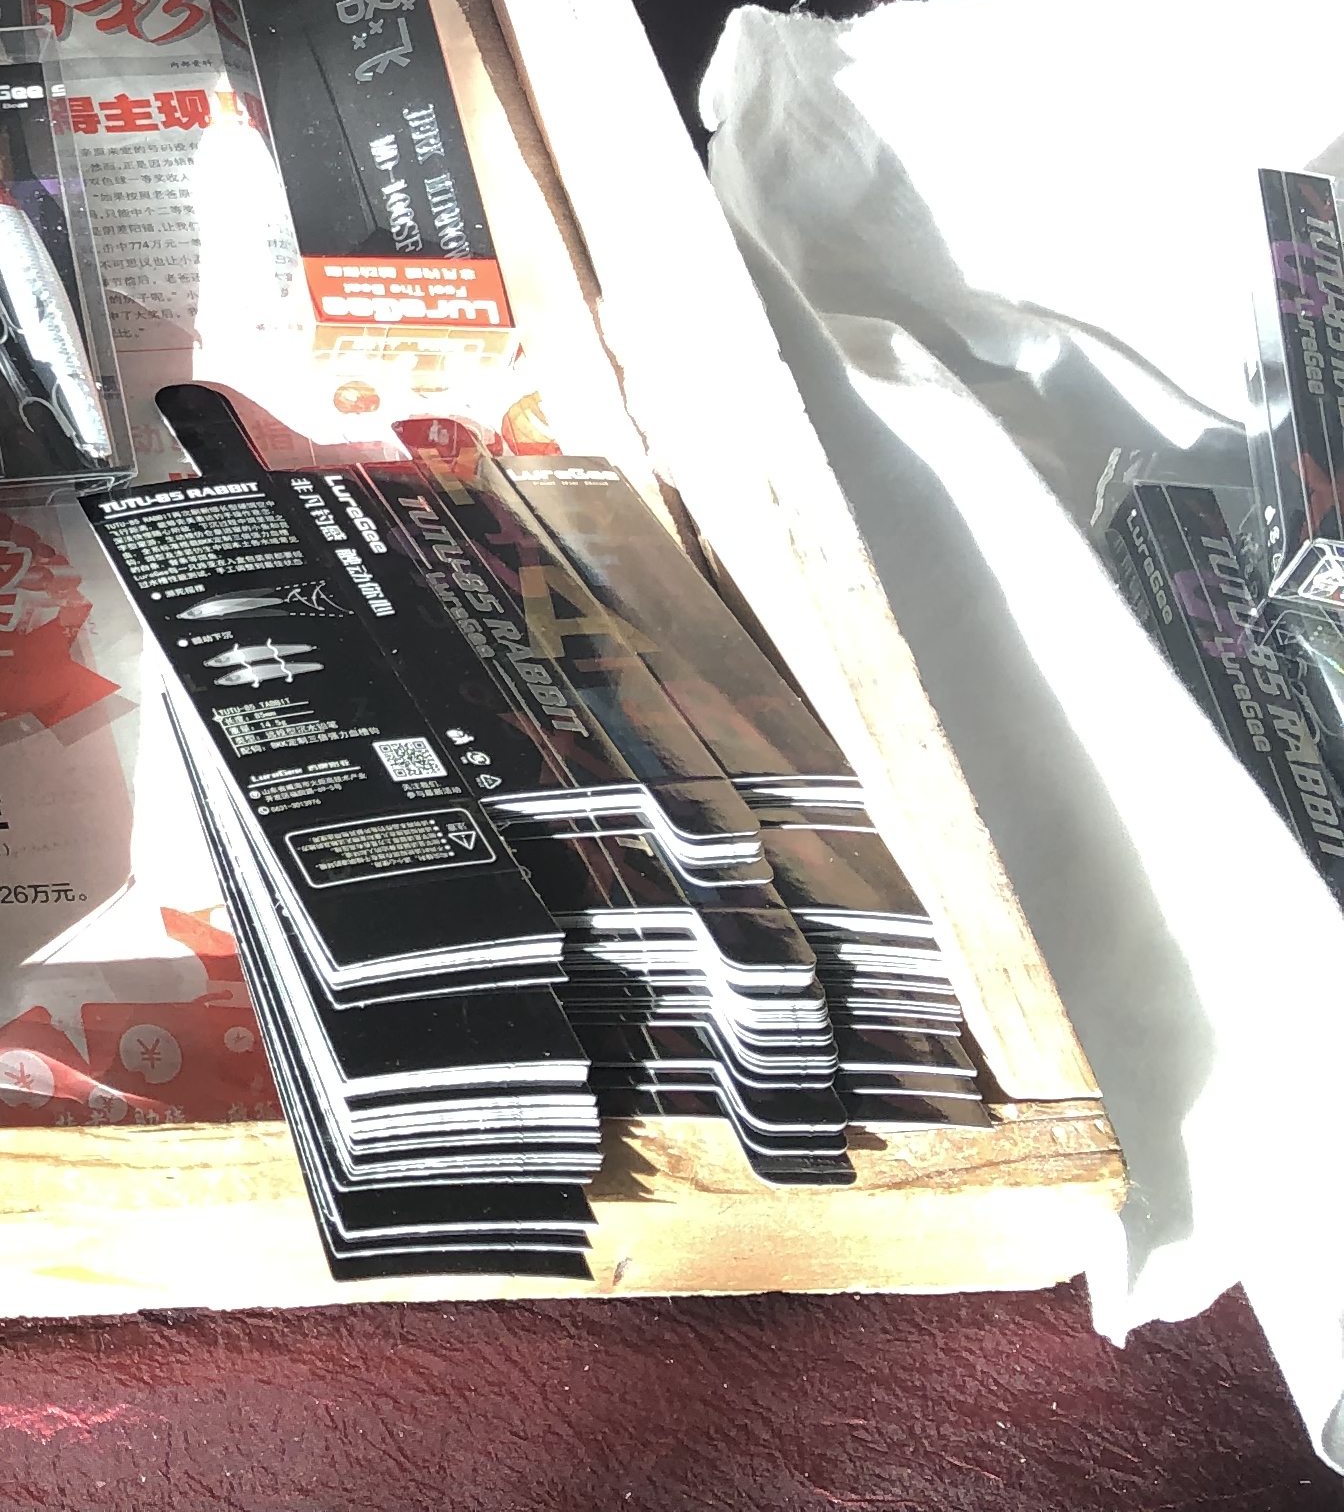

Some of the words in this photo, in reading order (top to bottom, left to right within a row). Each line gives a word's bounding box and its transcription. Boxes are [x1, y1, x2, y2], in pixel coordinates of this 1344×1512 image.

[99, 491, 184, 513] TUTU-85
[187, 482, 258, 498] RABBIT
[325, 475, 387, 554] LureGee
[398, 495, 504, 613] TUTU-85
[483, 618, 589, 738] RABBIT
[426, 572, 495, 658] LureGee
[1125, 517, 1172, 626] LureGee
[1201, 535, 1291, 710] TUTU-85
[1215, 635, 1271, 753] LureGee
